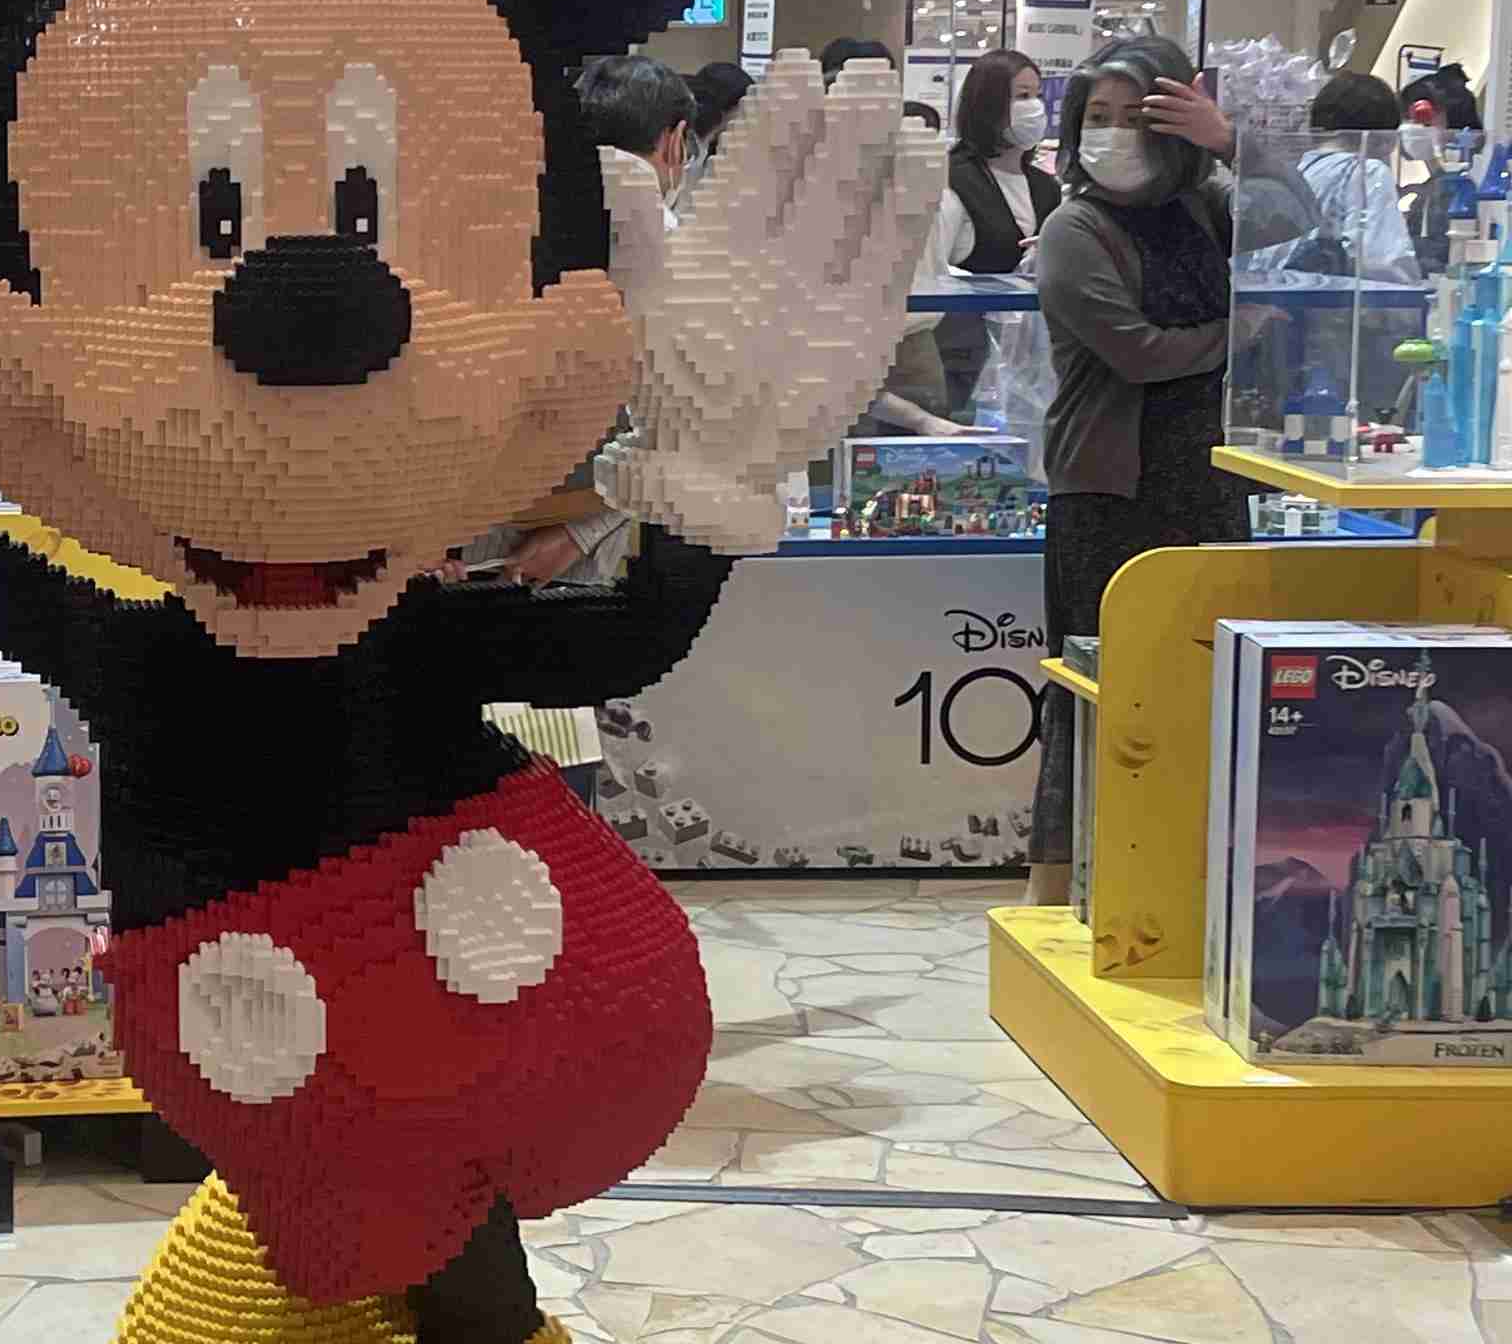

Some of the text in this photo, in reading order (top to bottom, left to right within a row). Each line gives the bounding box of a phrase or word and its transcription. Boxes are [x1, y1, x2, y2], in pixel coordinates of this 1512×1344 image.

[944, 609, 1046, 653] Disn
[1272, 655, 1437, 699] LEGO Disney
[894, 667, 1045, 766] 10
[1268, 706, 1304, 723] 14+
[1433, 1042, 1505, 1057] FROZEN
